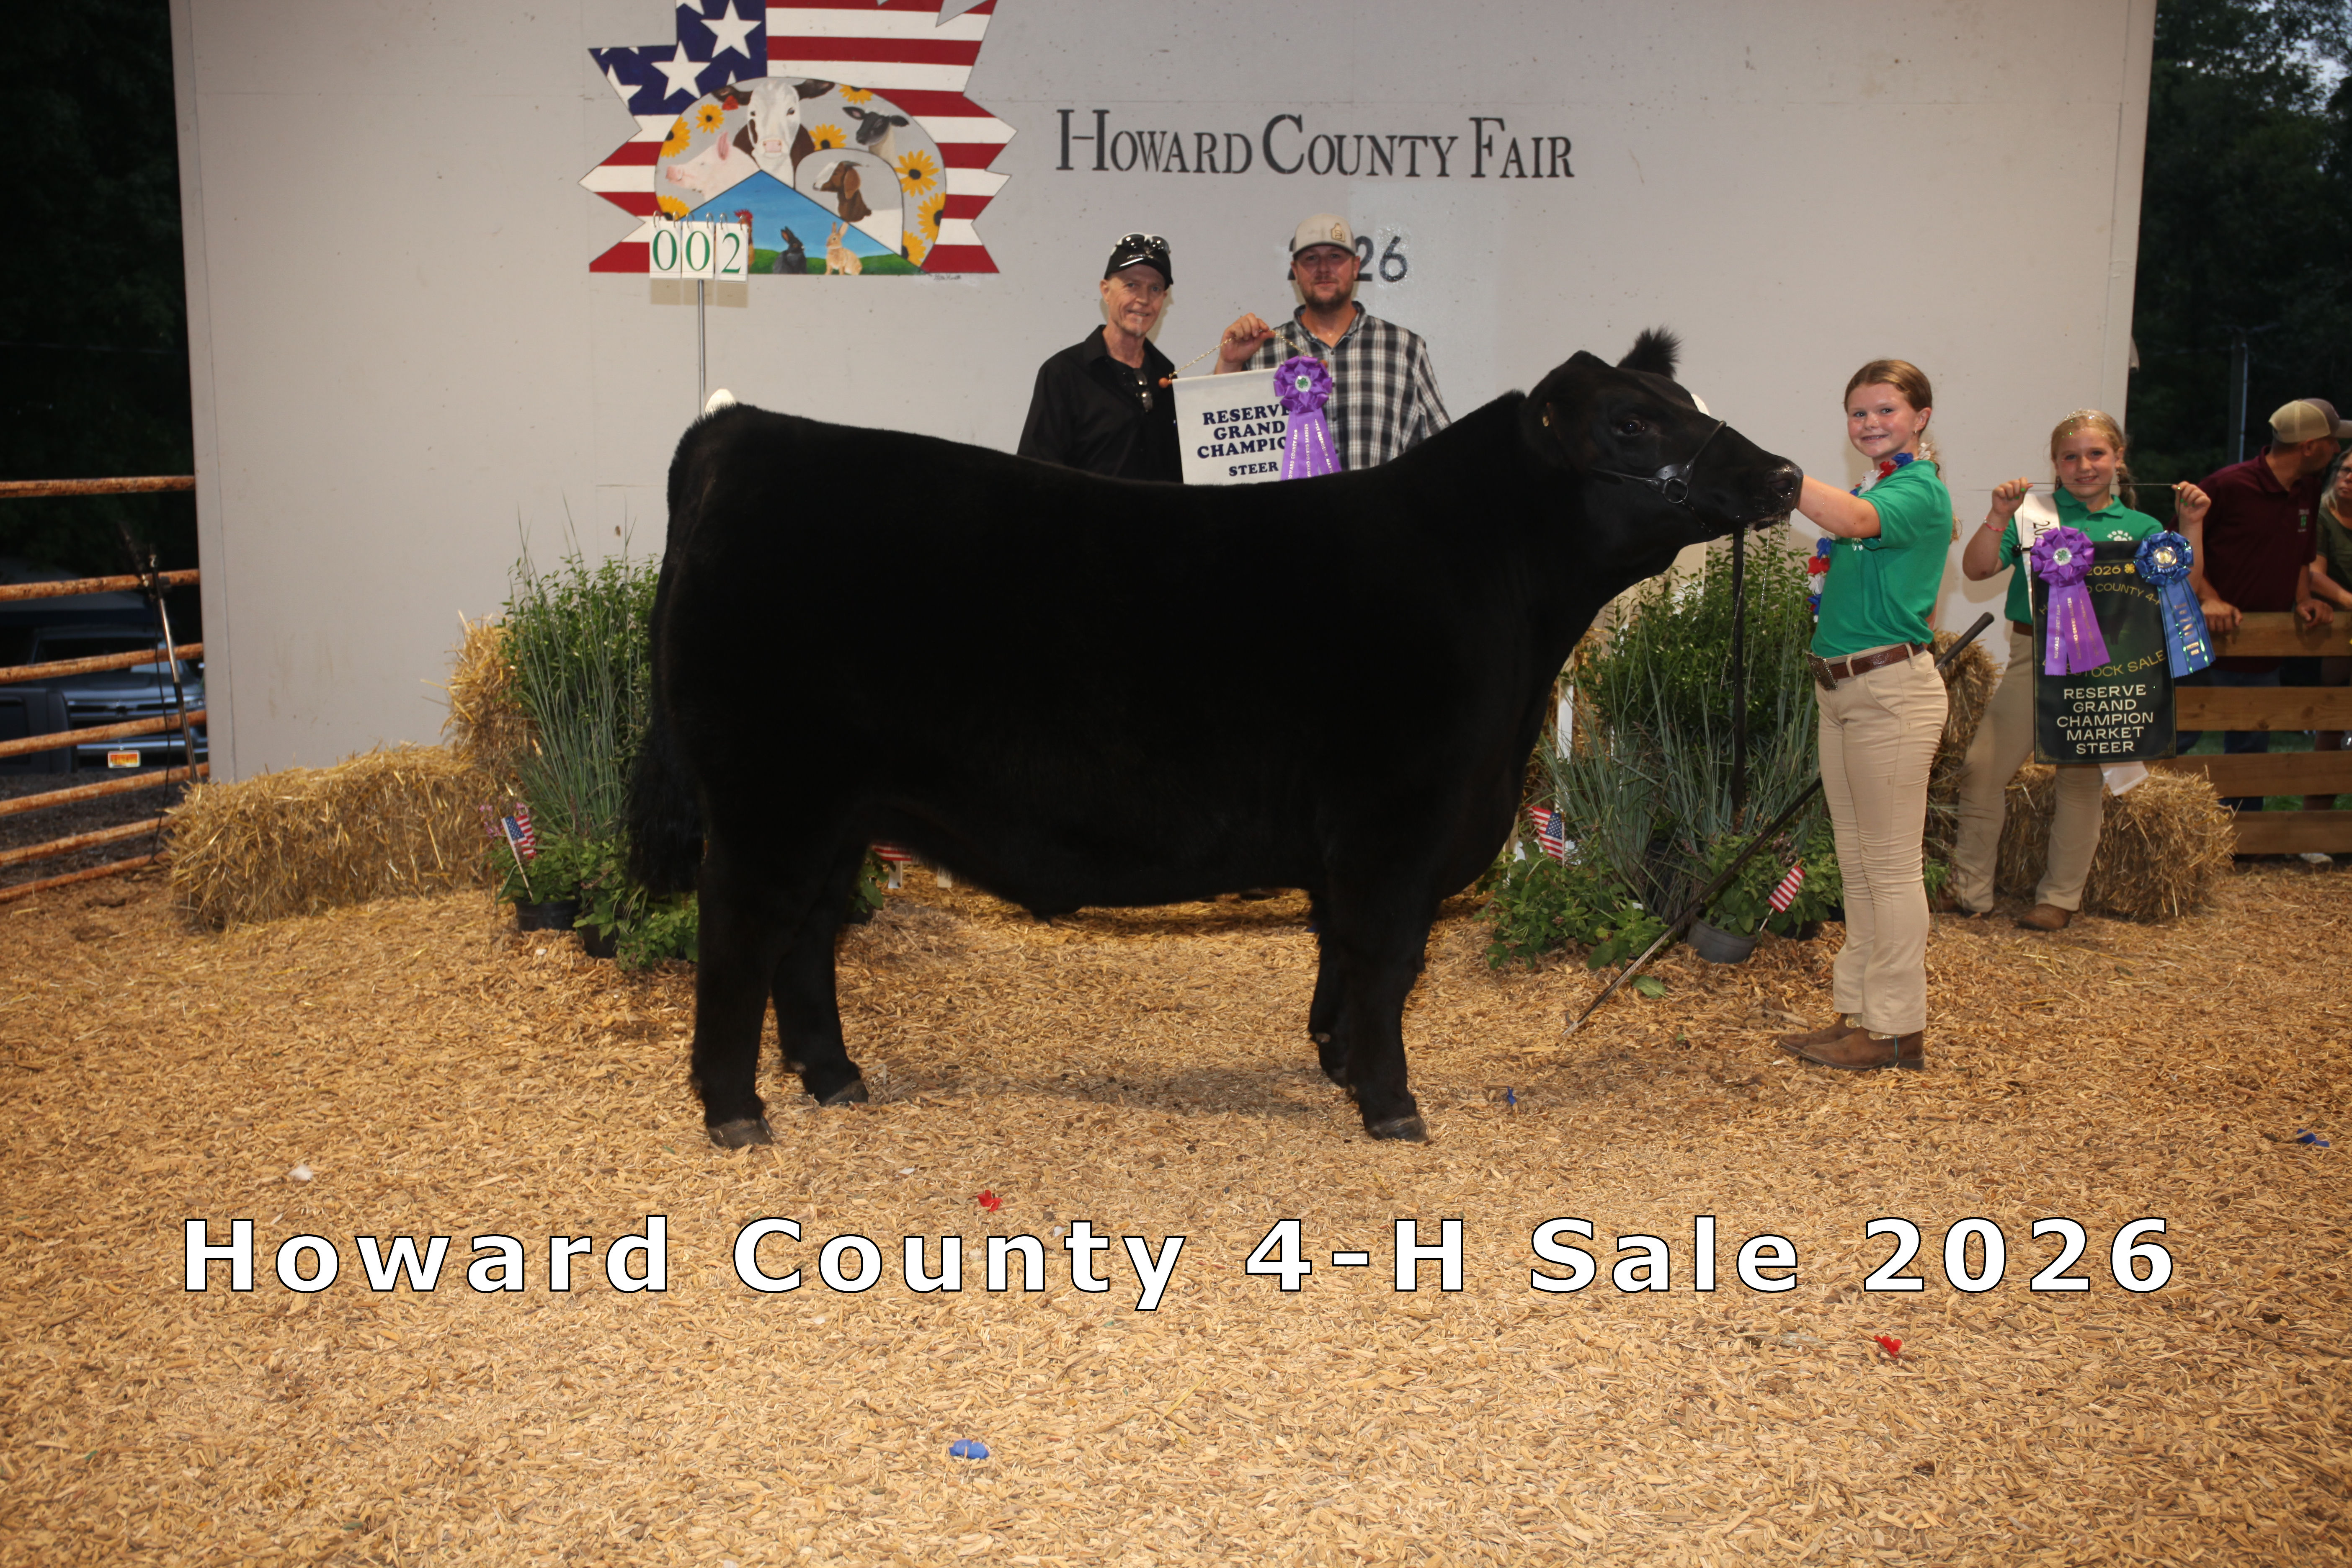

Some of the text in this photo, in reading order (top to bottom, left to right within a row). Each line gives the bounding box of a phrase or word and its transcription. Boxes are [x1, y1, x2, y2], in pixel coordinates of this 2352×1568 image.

[1055, 108, 1575, 179] HOWARD COUNTY FAIR
[652, 229, 741, 273] 002
[1213, 420, 1285, 440] GRAND
[1197, 436, 1286, 459] CHAMPIO
[1229, 462, 1279, 477] STEER
[2107, 529, 2133, 541] HOWAR
[2095, 583, 2144, 597] COUNTY
[2127, 650, 2166, 673] SALE
[2063, 684, 2146, 700] RESERVE
[2073, 699, 2137, 713] GRAND
[2056, 712, 2154, 727] CHAMPION
[2066, 726, 2144, 741] MARKET
[2076, 740, 2135, 754] STEER
